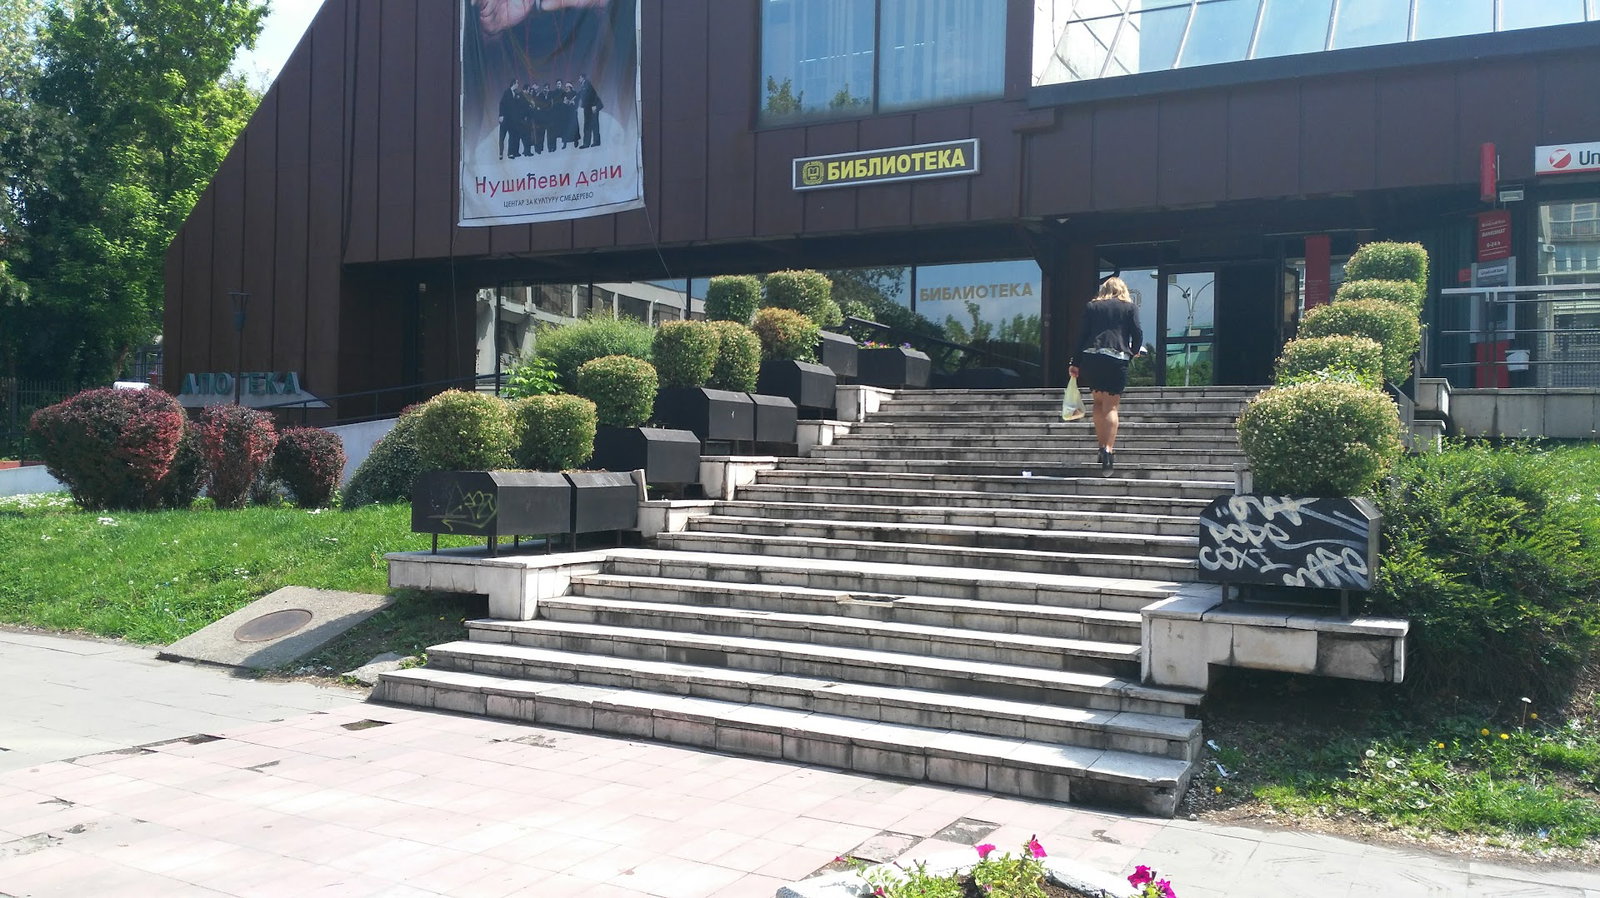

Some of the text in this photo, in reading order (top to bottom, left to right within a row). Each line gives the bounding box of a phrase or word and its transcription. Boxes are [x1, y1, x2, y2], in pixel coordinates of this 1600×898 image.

[827, 148, 966, 181] БИБЛИОТЕКА
[475, 172, 570, 197] Нушићеви
[503, 191, 594, 208] ЦЕНТАР ЗА КУЛТУРУ СМЕДЕРЕВО
[919, 282, 1033, 302] БИБЛИОТЕКА
[181, 371, 300, 395] АПОТЕКА
